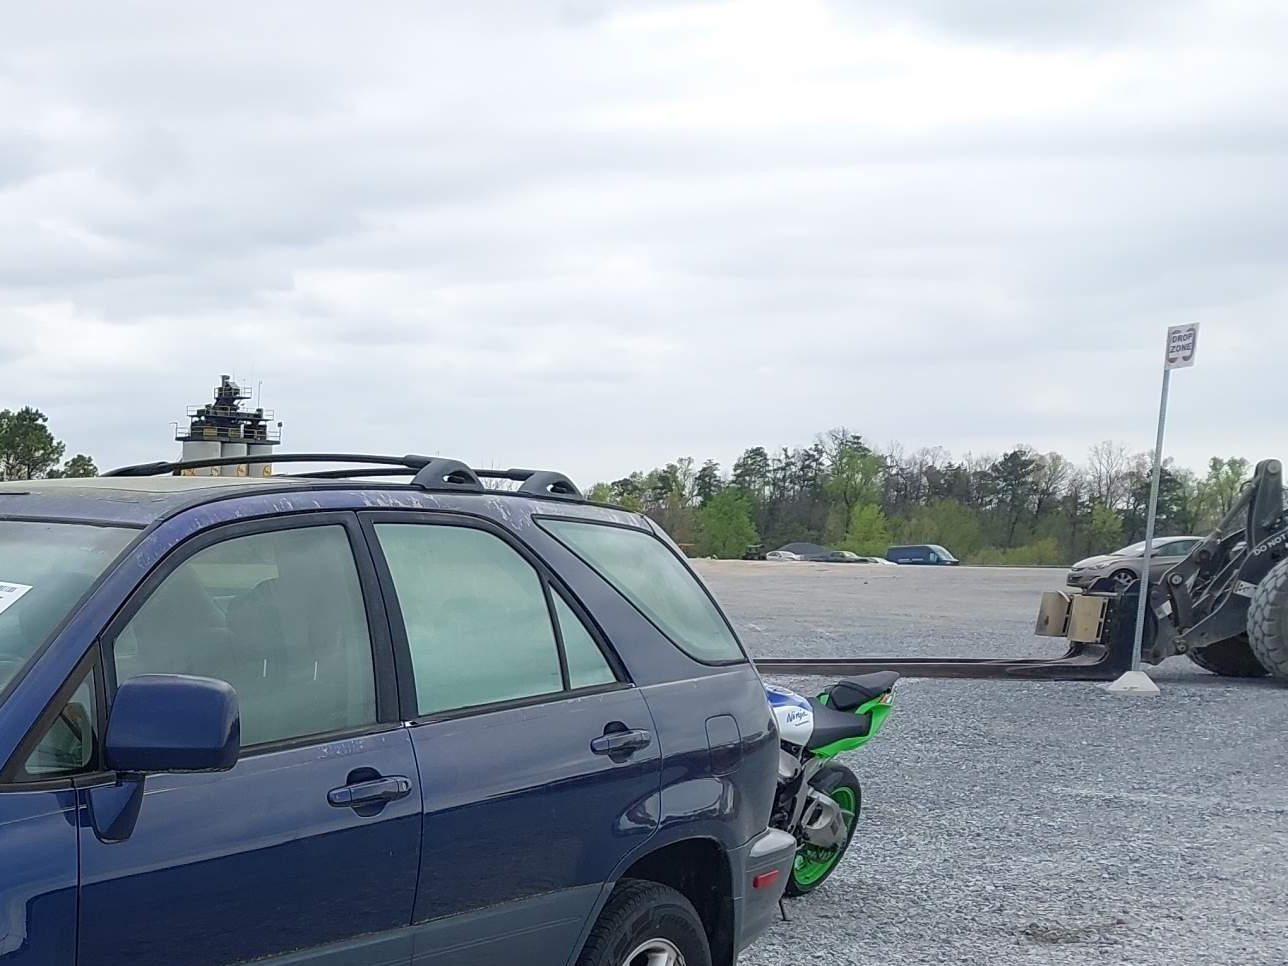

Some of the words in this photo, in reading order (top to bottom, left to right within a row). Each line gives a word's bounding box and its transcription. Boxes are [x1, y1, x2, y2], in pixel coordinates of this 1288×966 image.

[1172, 333, 1192, 343] DROP
[1169, 343, 1192, 353] ZONE
[1254, 544, 1268, 556] DO
[1267, 533, 1287, 548] NOT
